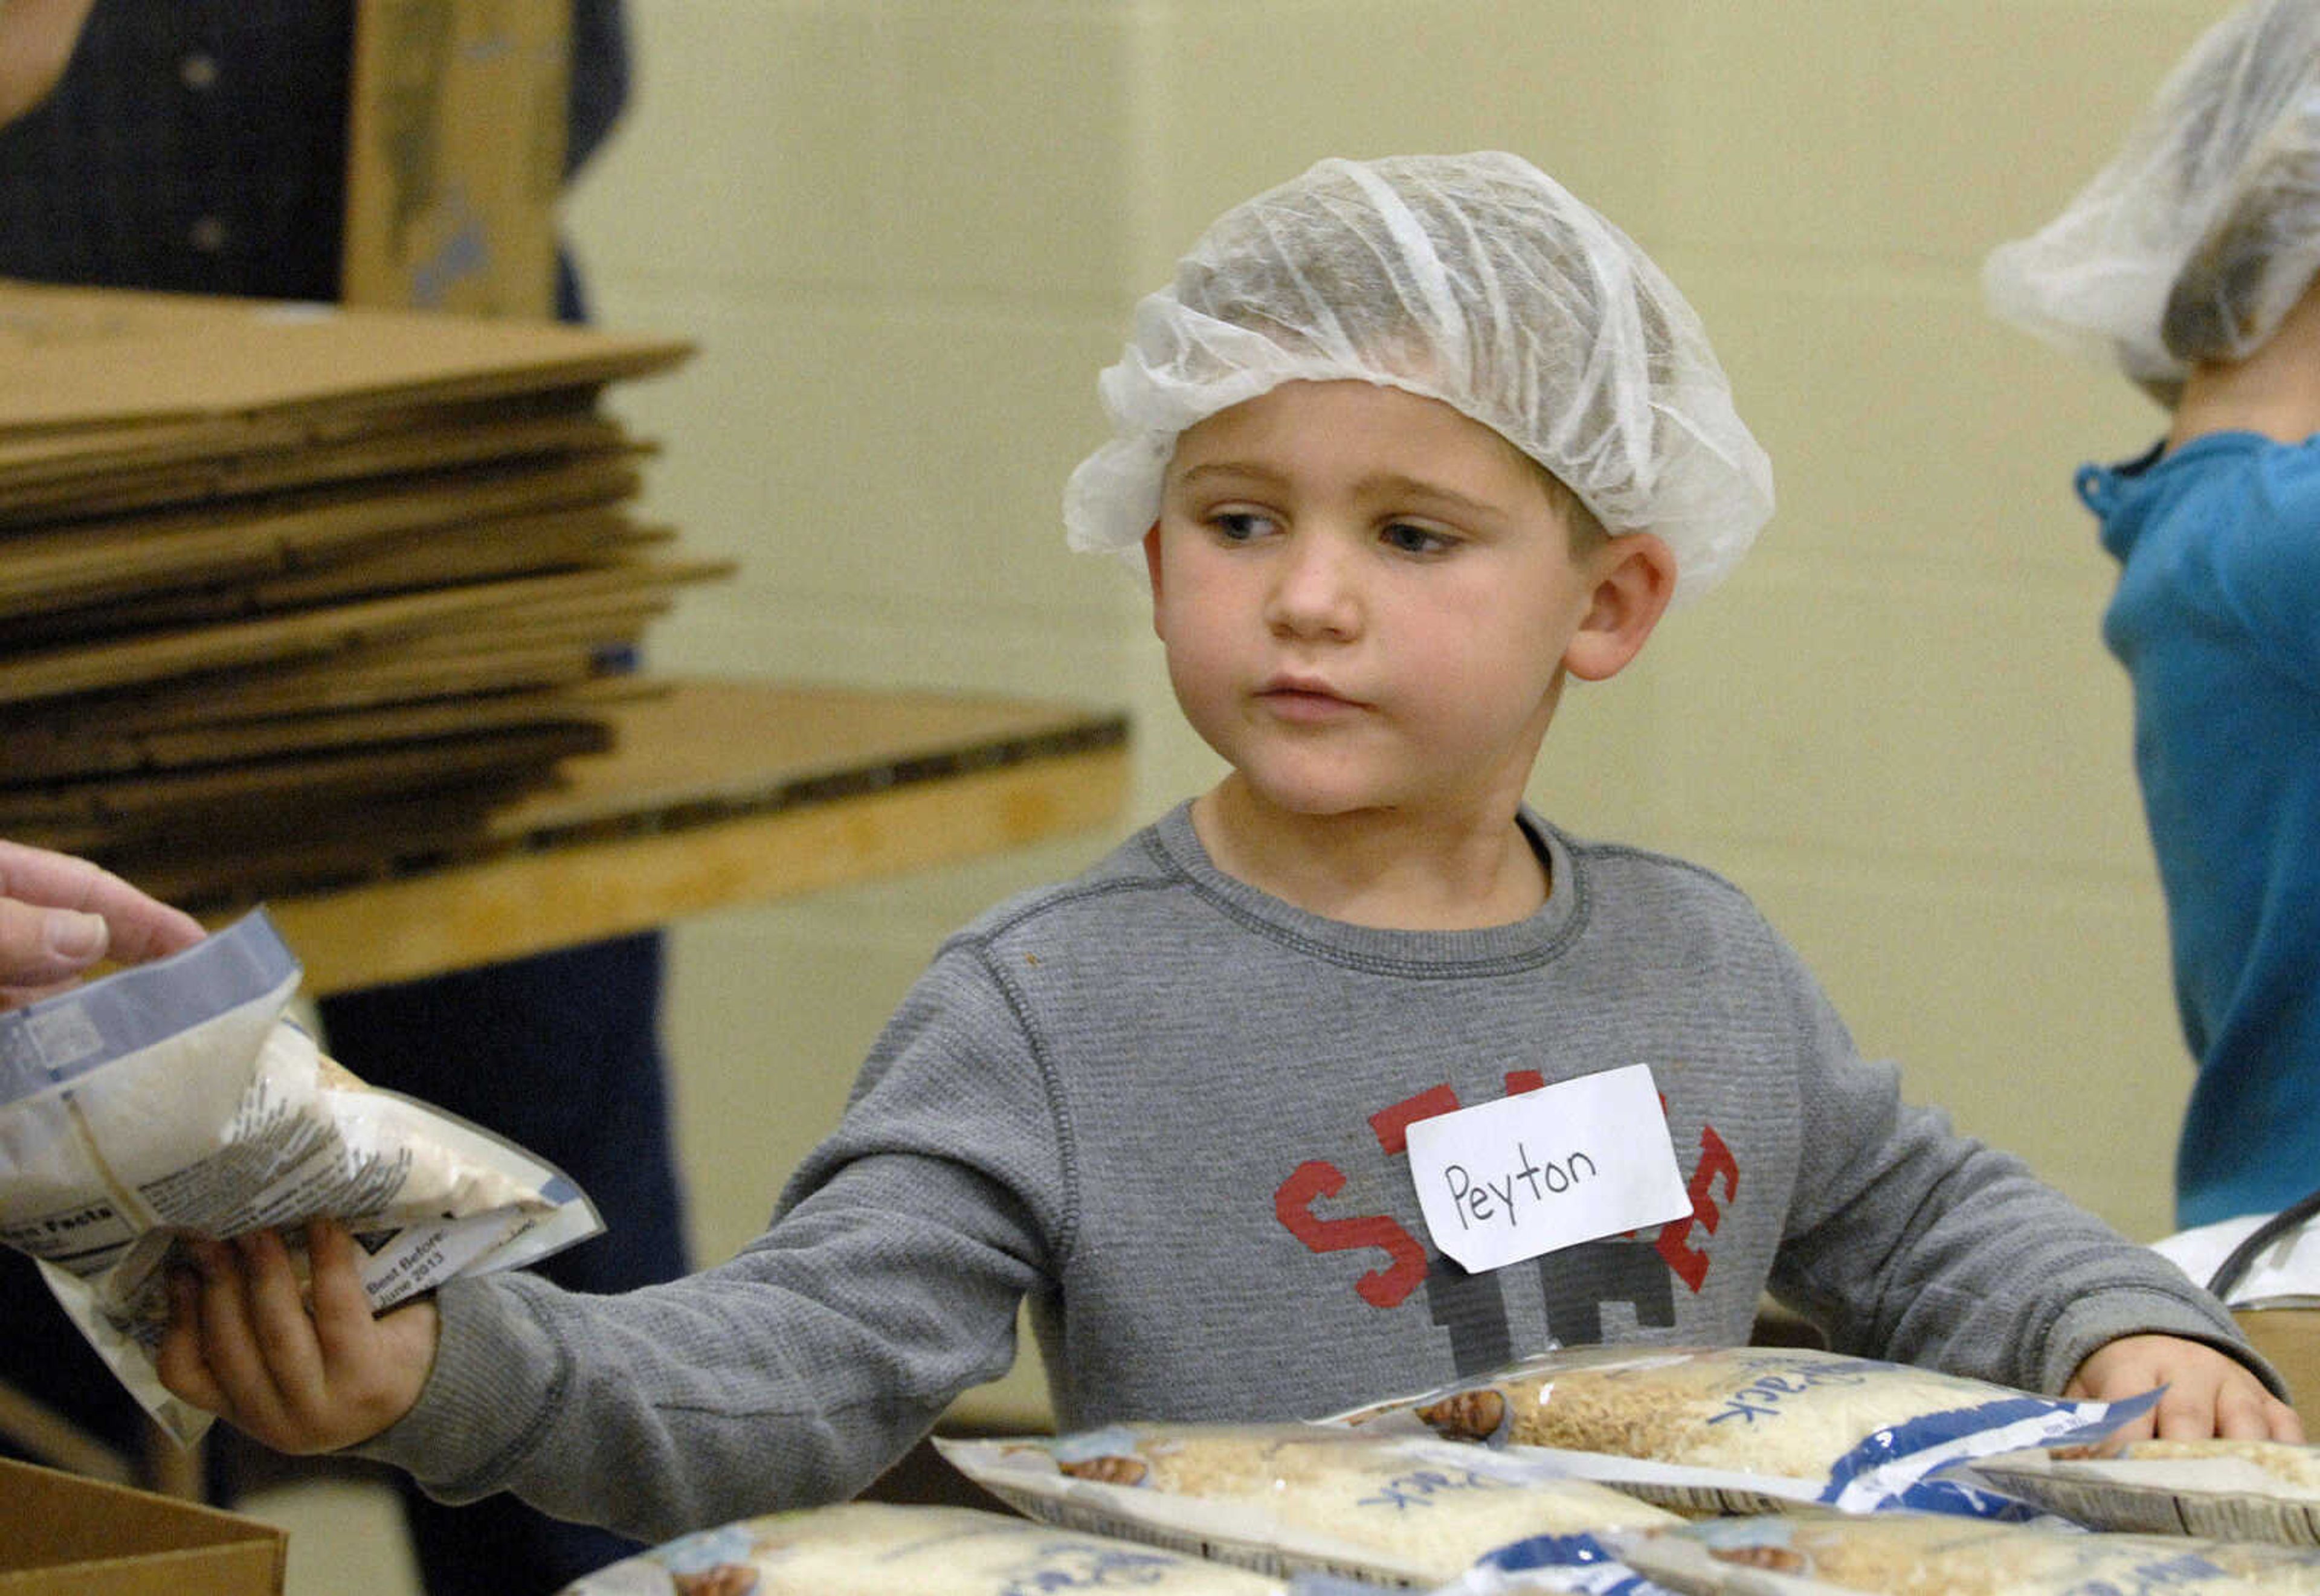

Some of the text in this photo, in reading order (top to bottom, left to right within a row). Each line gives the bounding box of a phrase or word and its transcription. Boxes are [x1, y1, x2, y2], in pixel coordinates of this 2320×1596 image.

[1445, 1142, 1597, 1231] Peyton
[366, 1267, 399, 1295] Best
[411, 1252, 444, 1282] 2013
